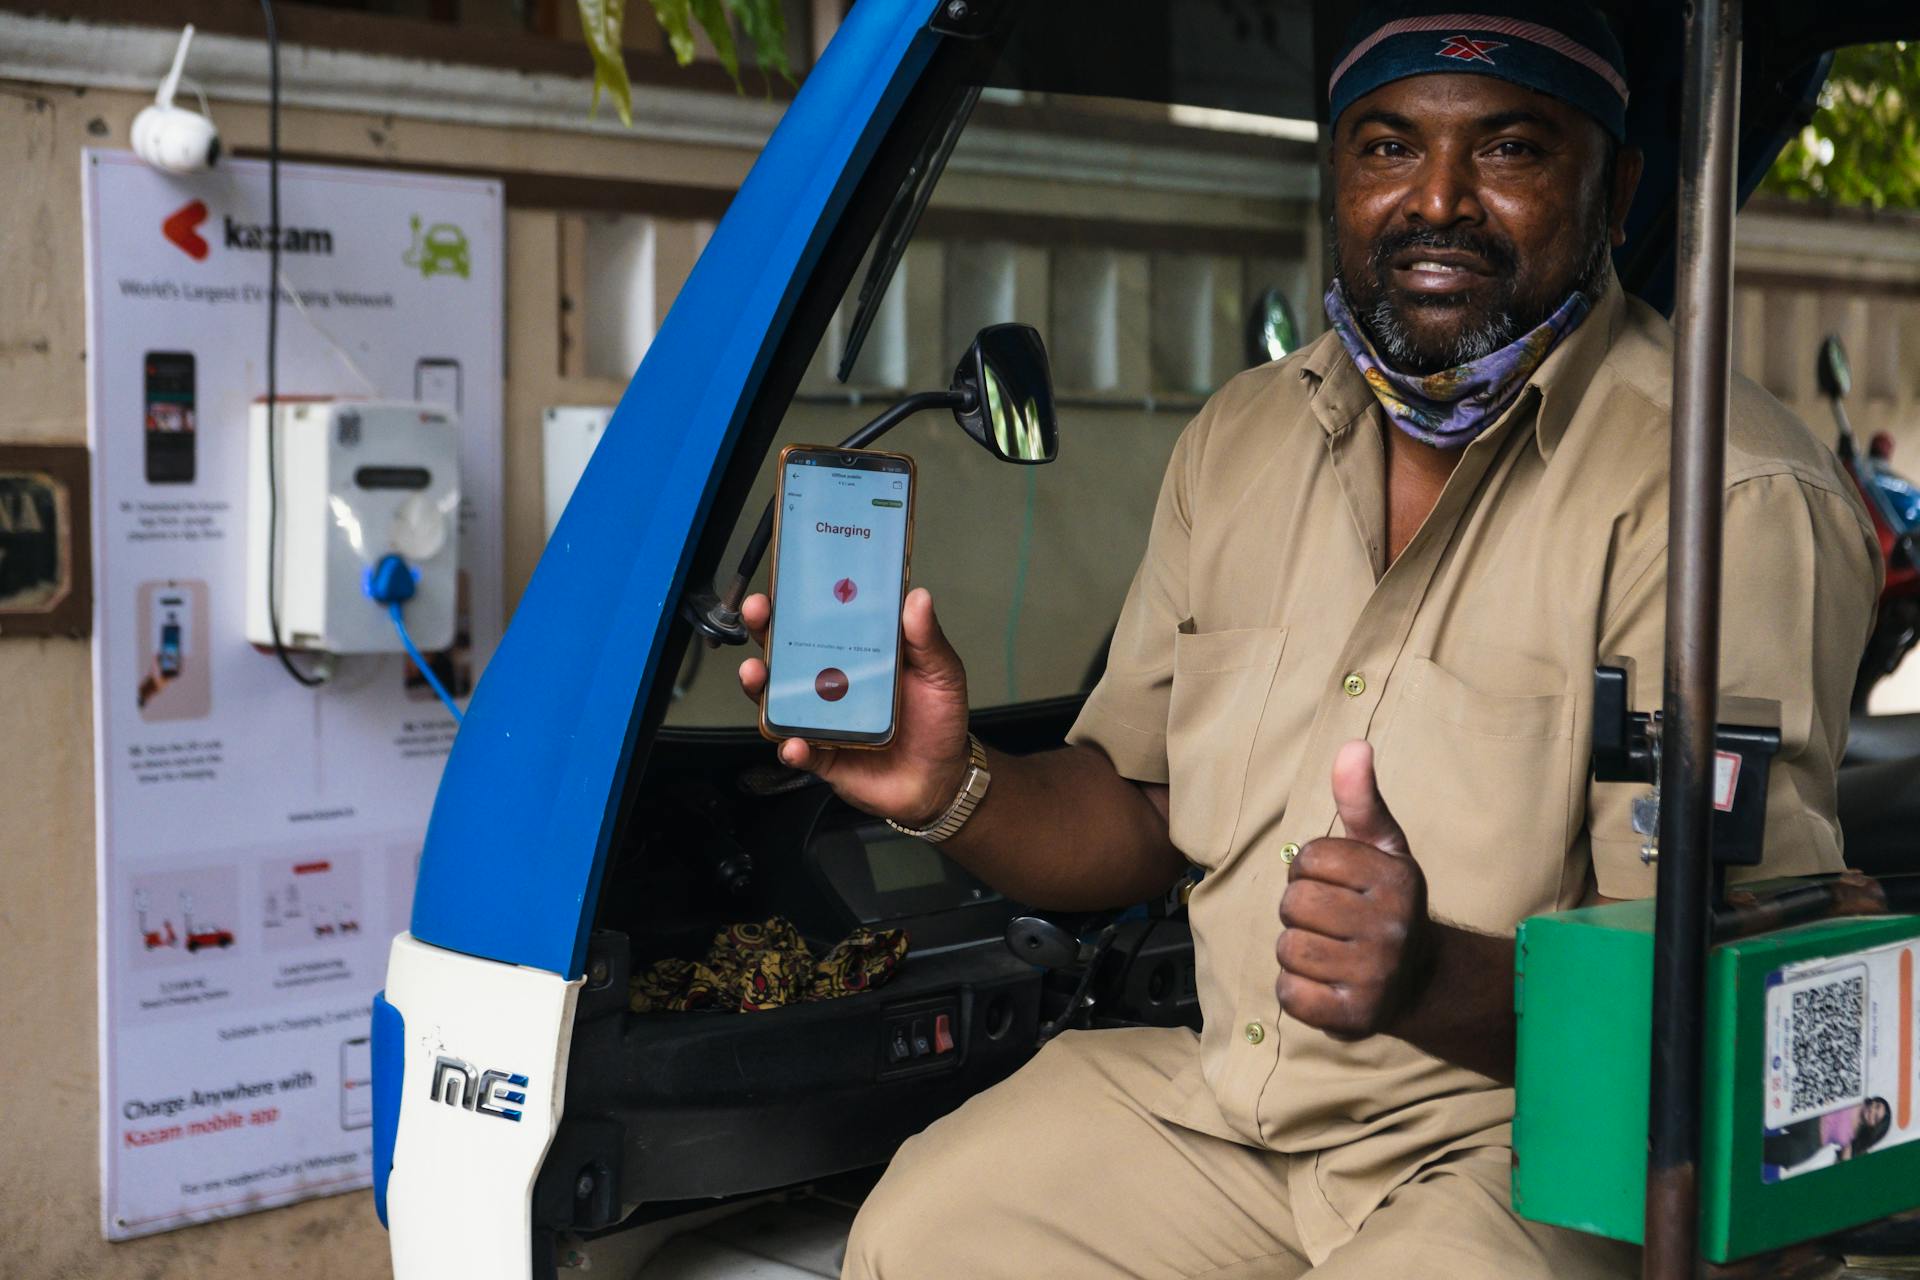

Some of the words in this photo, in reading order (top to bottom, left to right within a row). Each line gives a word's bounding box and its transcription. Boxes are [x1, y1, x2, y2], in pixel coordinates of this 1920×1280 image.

[224, 216, 334, 254] kazam
[266, 287, 330, 307] harging
[816, 522, 871, 538] Charging
[123, 1097, 185, 1121] Charge
[189, 1081, 274, 1107] Anywhere
[279, 1070, 315, 1091] with
[123, 1124, 183, 1149] Kazam
[187, 1110, 245, 1135] mobile
[249, 1106, 280, 1127] app
